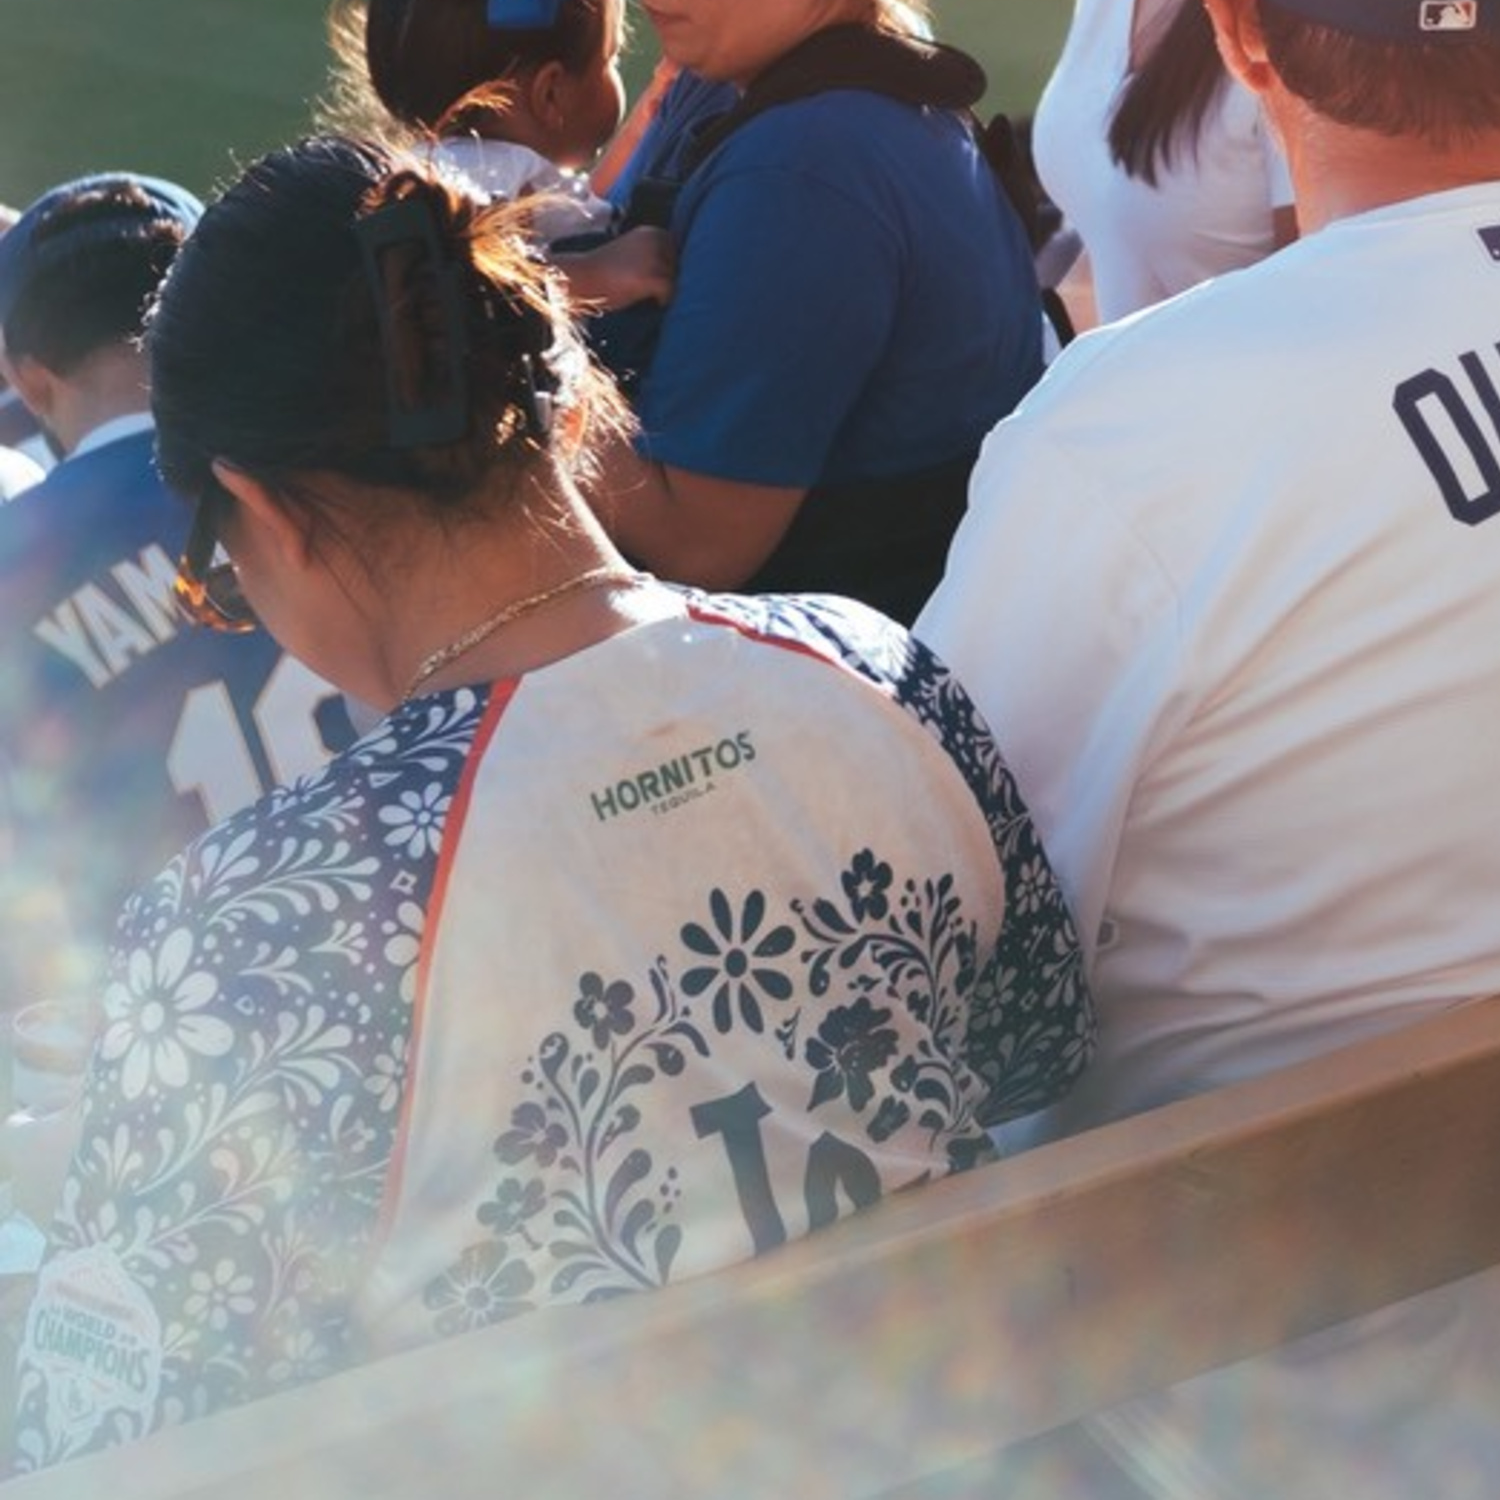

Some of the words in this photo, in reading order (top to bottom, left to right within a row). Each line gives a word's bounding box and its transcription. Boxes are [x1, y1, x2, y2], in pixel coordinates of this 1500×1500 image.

[33, 541, 232, 689] YAM
[589, 729, 757, 822] HORNITOS
[650, 781, 717, 816] TEQUILA
[34, 1308, 149, 1393] CHAMPIONS
